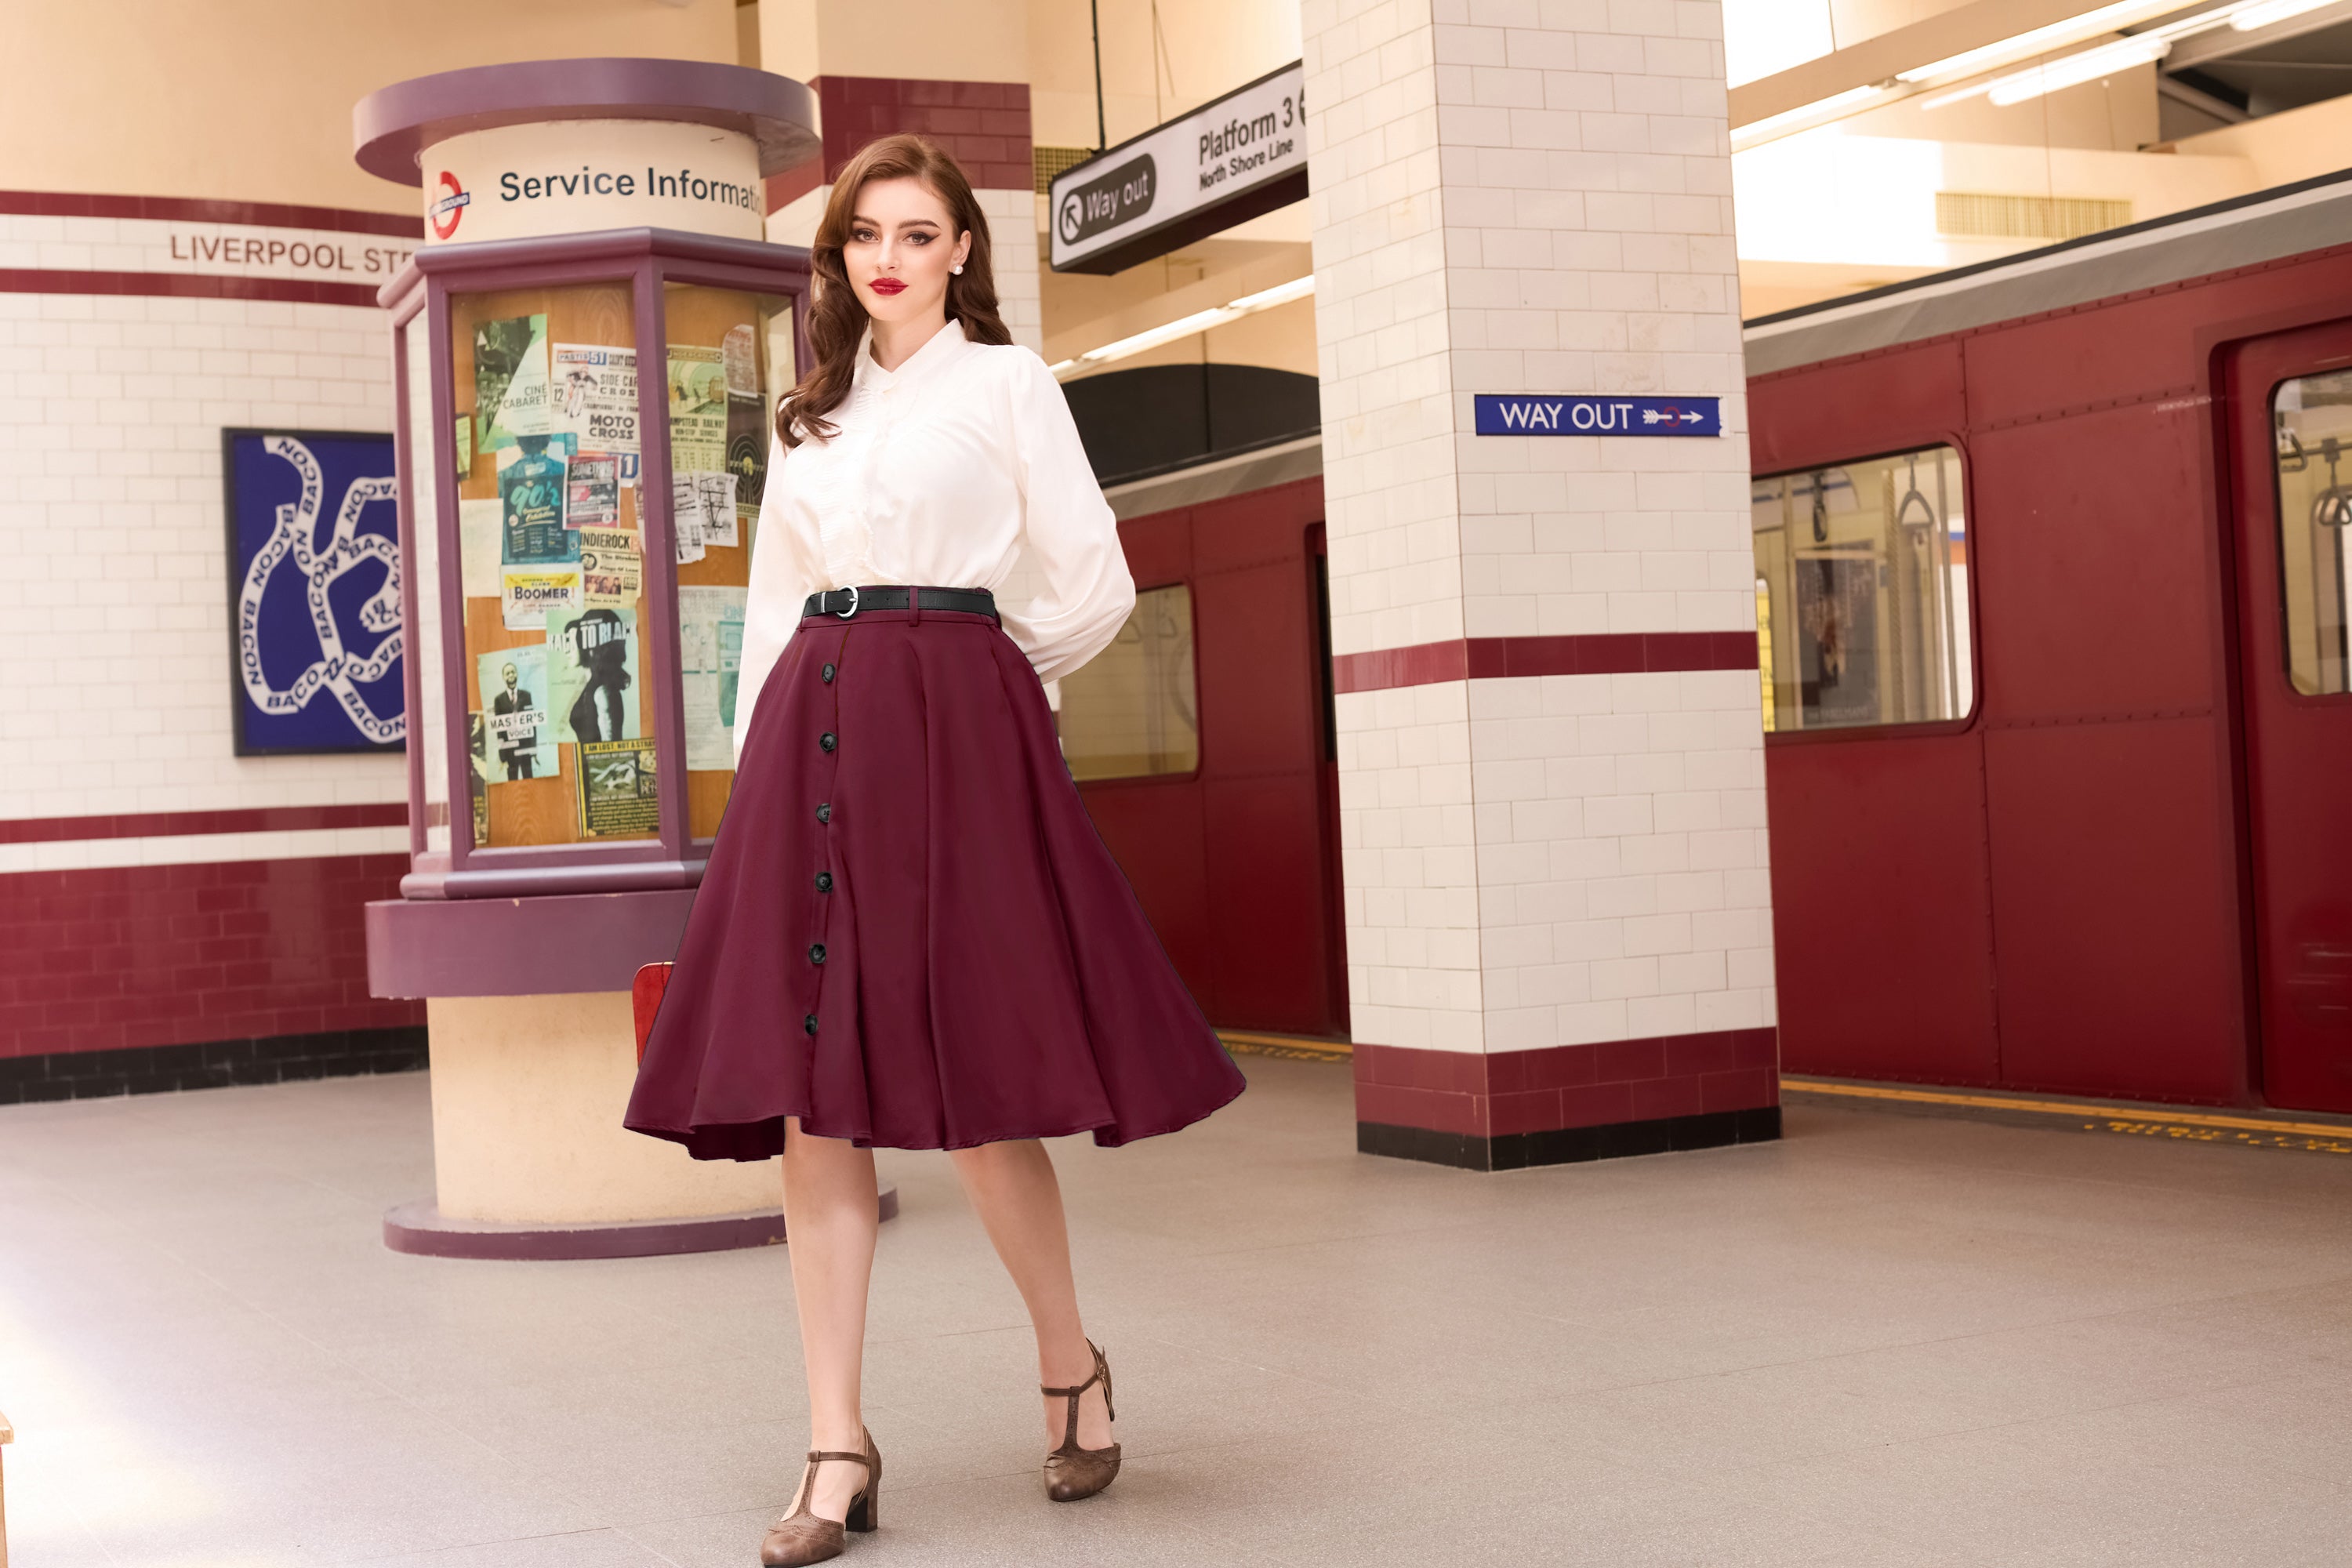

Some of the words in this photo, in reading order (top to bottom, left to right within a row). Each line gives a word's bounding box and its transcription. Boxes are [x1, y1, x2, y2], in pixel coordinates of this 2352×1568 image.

[1200, 111, 1276, 165] Platform
[1283, 96, 1293, 128] 3
[1200, 159, 1227, 191] North
[1230, 151, 1265, 176] Shore
[1269, 138, 1293, 162] Line
[499, 166, 635, 201] Service
[1086, 190, 1120, 222] Way
[1123, 173, 1149, 205] out
[171, 235, 354, 270] LIVERPOOL
[590, 352, 605, 365] 51
[524, 382, 546, 396] CINÉ
[601, 374, 619, 387] SIDE
[503, 395, 547, 409] CABARET
[554, 389, 564, 402] 12
[590, 415, 635, 428] MOTO
[1499, 403, 1563, 429] WAY
[1572, 403, 1634, 430] OUT
[590, 427, 634, 440] CROSS
[278, 441, 317, 515] BACON
[252, 509, 294, 587] BACON
[581, 532, 630, 549] INDIEROCK
[514, 586, 569, 600] BOOMER
[241, 600, 262, 686] BACON
[580, 625, 597, 650] TO
[508, 727, 532, 738] VOICE
